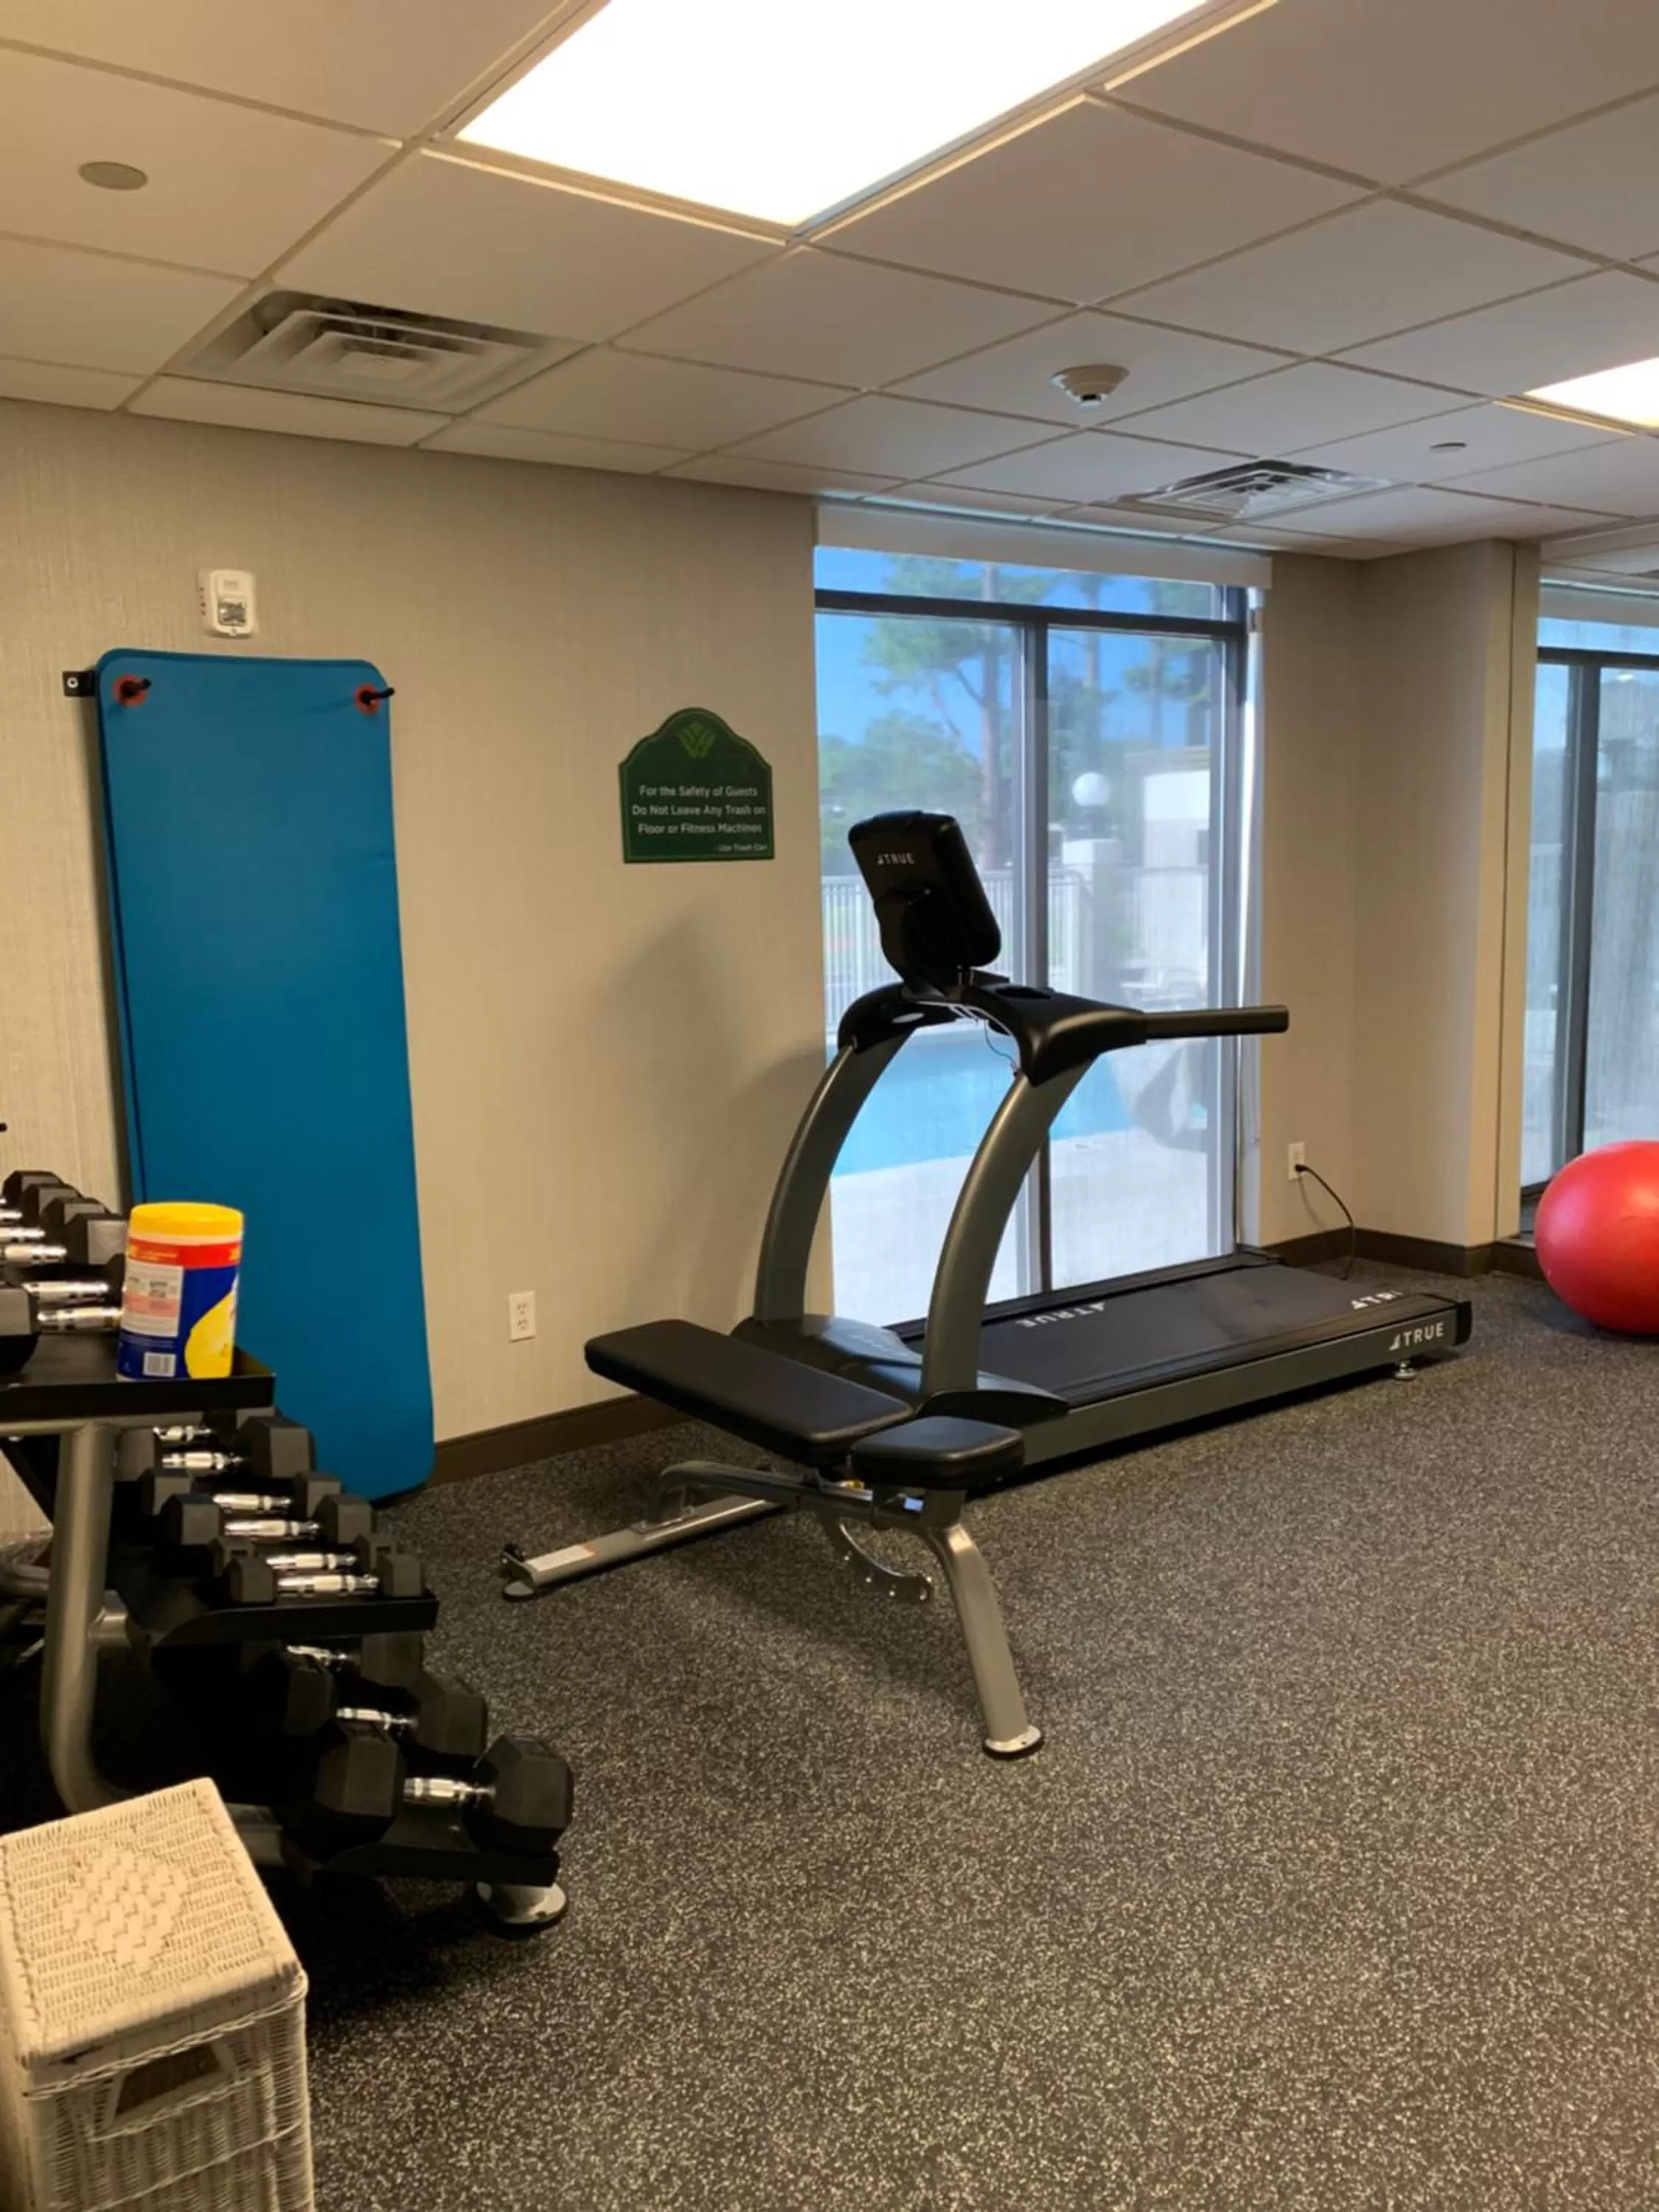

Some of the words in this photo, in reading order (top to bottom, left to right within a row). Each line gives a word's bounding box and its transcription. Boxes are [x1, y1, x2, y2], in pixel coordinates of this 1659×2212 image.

[639, 785, 657, 796] For
[660, 786, 676, 796] the
[678, 786, 709, 798] Safety
[712, 786, 723, 796] of
[725, 786, 758, 796] Guests
[632, 804, 647, 815] Do
[650, 805, 669, 815] Not
[670, 804, 700, 815] Leave
[703, 804, 723, 817] Any
[725, 804, 751, 815] Trash
[753, 807, 766, 815] on
[638, 823, 666, 834] Floor
[667, 825, 678, 833] or
[884, 852, 914, 864] TRUE
[1403, 1321, 1444, 1346] TRUE
